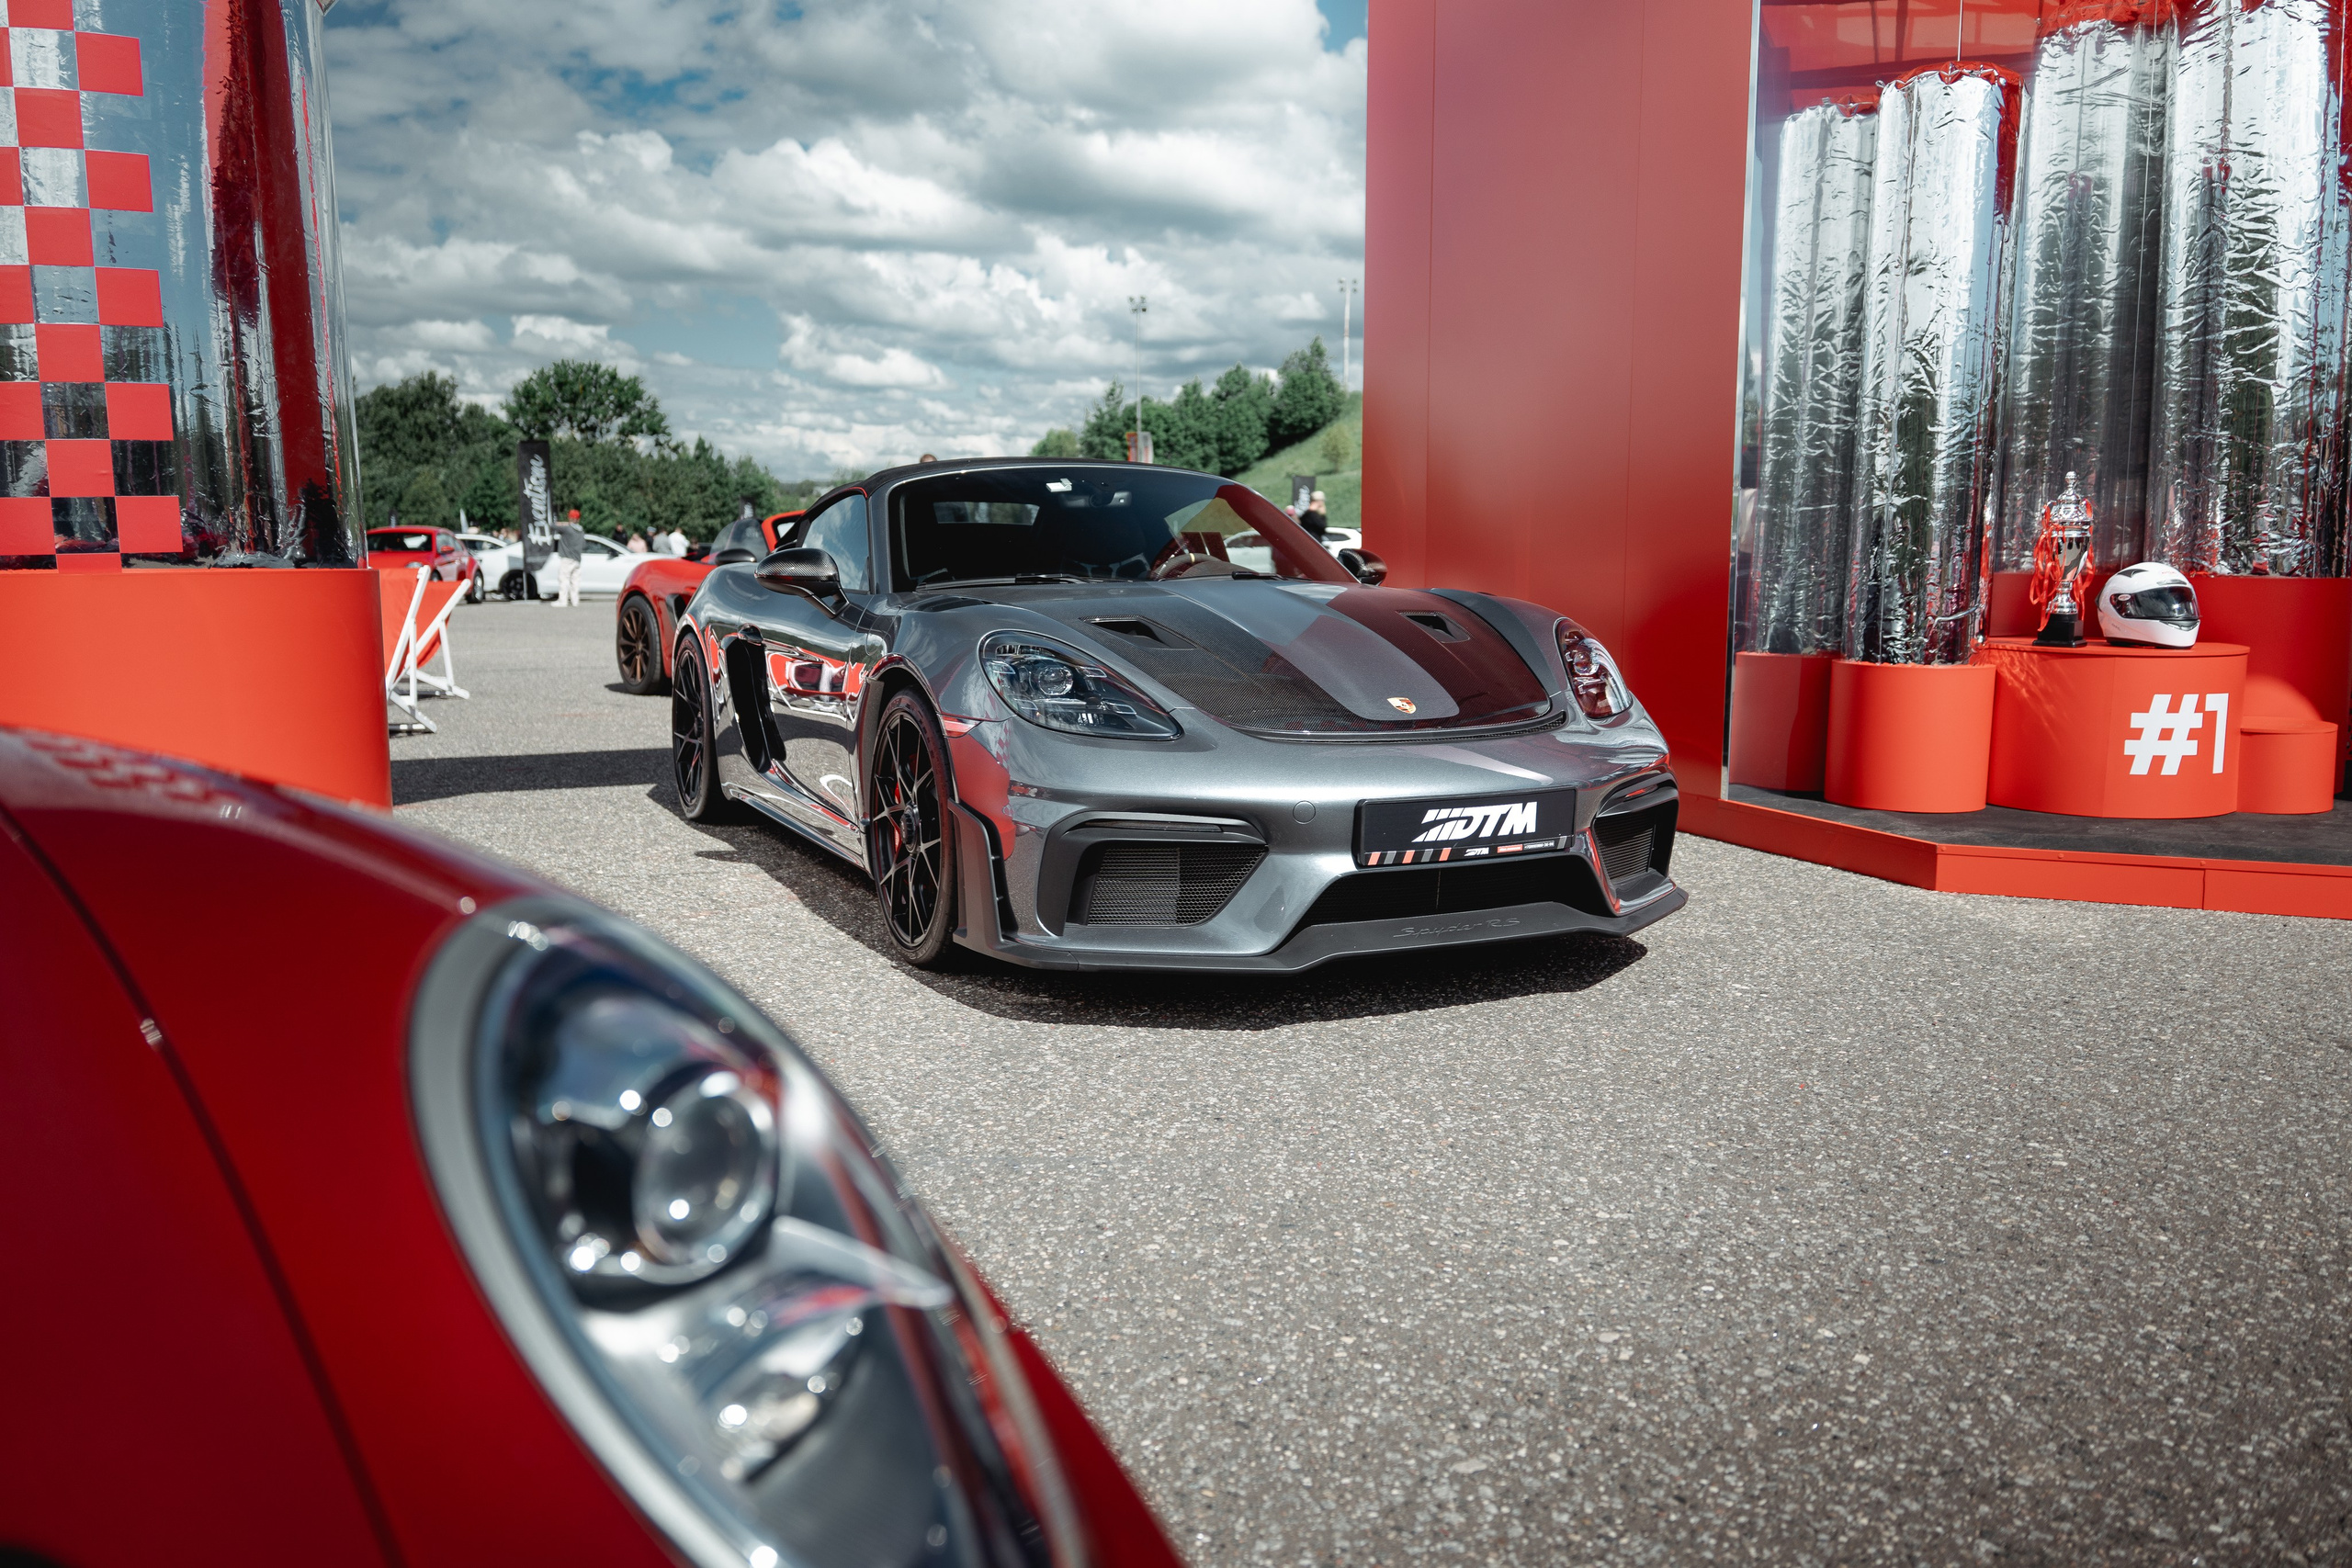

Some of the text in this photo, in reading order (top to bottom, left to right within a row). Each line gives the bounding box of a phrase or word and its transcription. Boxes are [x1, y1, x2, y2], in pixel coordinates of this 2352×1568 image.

[523, 455, 551, 546] Eventism
[2124, 693, 2229, 775] #1
[1414, 801, 1538, 842] DTM
[1393, 919, 1521, 938] Spyder RS
